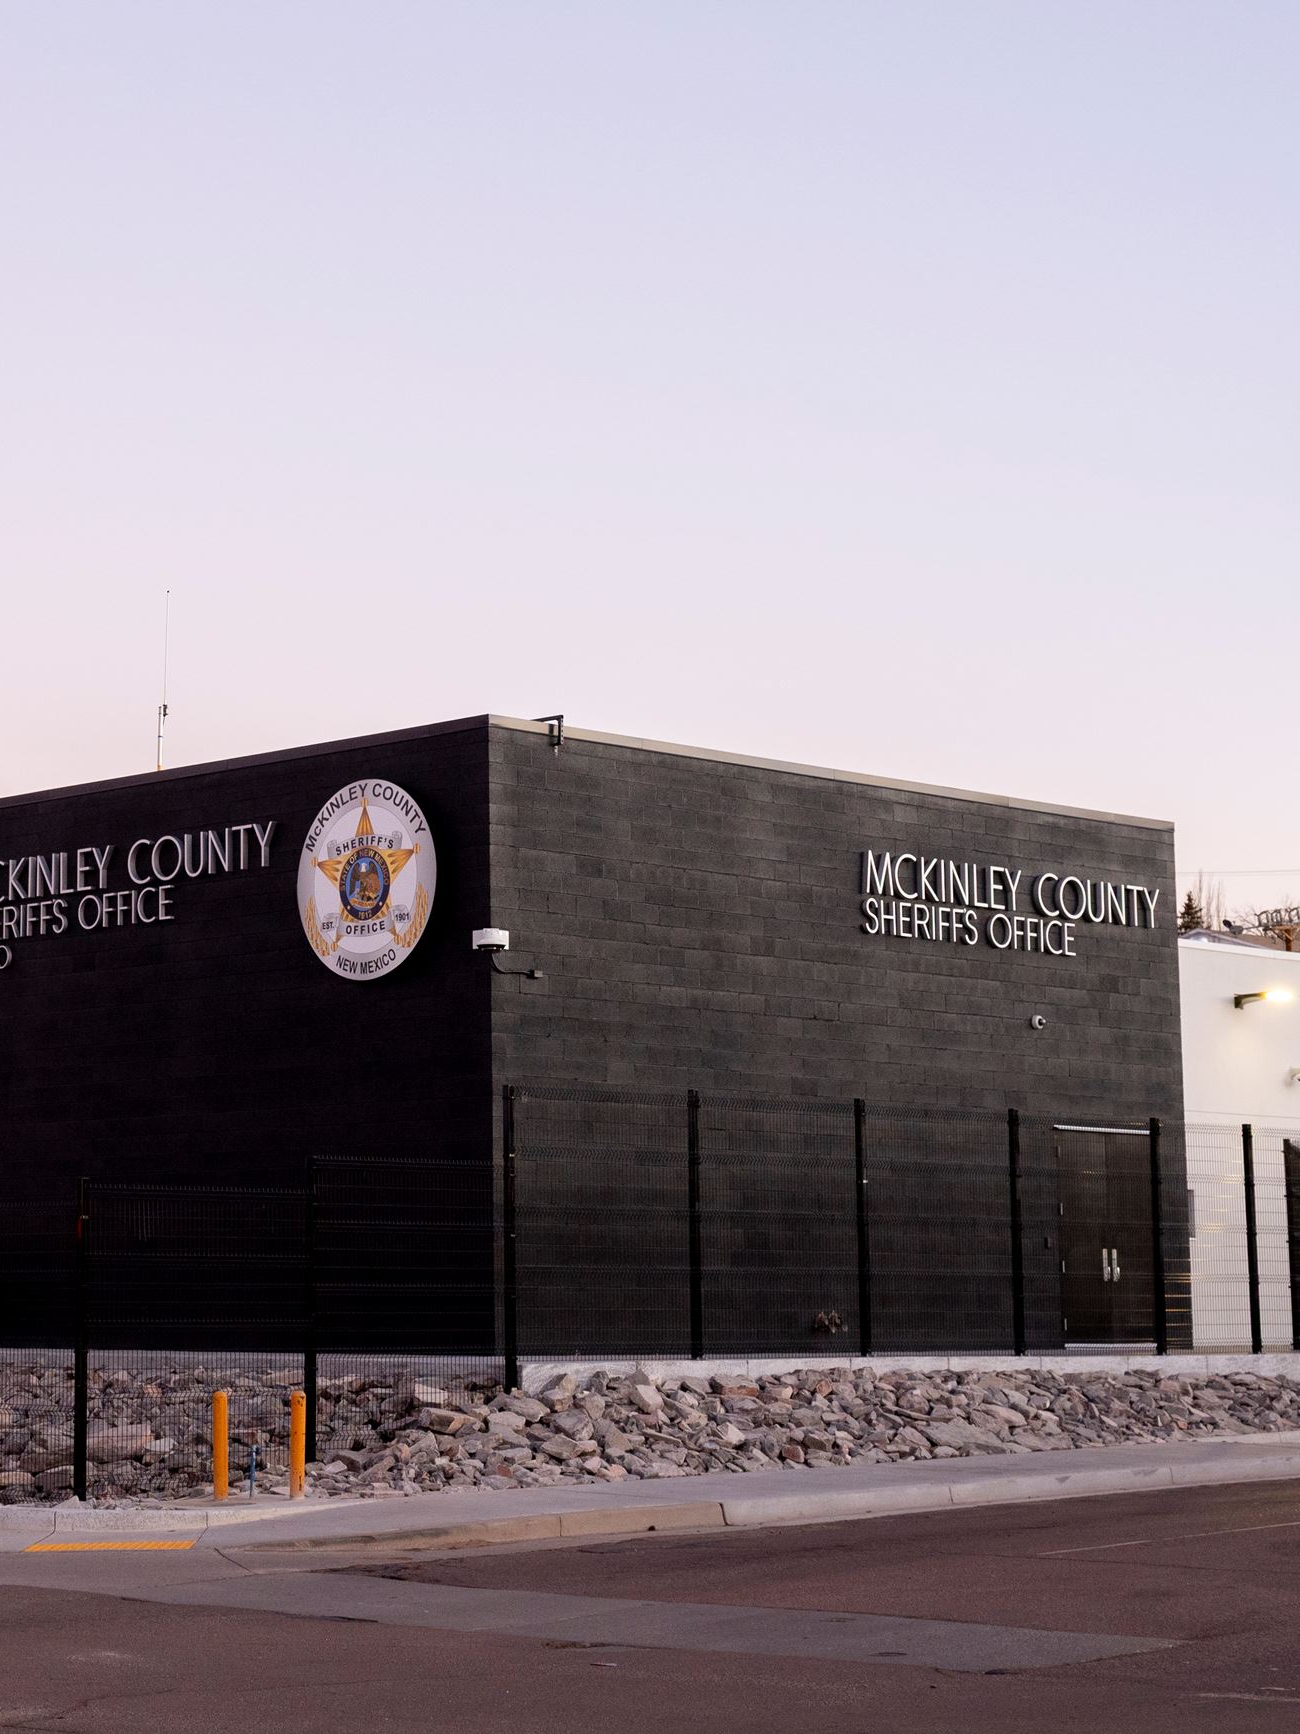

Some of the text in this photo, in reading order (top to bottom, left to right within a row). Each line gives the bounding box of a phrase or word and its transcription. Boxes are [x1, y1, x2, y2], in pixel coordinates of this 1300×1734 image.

[305, 782, 427, 853] McKINLEY COUNTY
[127, 821, 277, 885] COUNTY
[335, 835, 395, 856] SHERIFF'S
[78, 884, 175, 930] OFFICE
[863, 849, 1160, 929] MCKINLEY COUNTY
[321, 921, 335, 931] EST.
[345, 920, 386, 935] OFFICE
[988, 913, 1077, 957] OFFICE
[335, 948, 397, 975] NEW MEXICO
